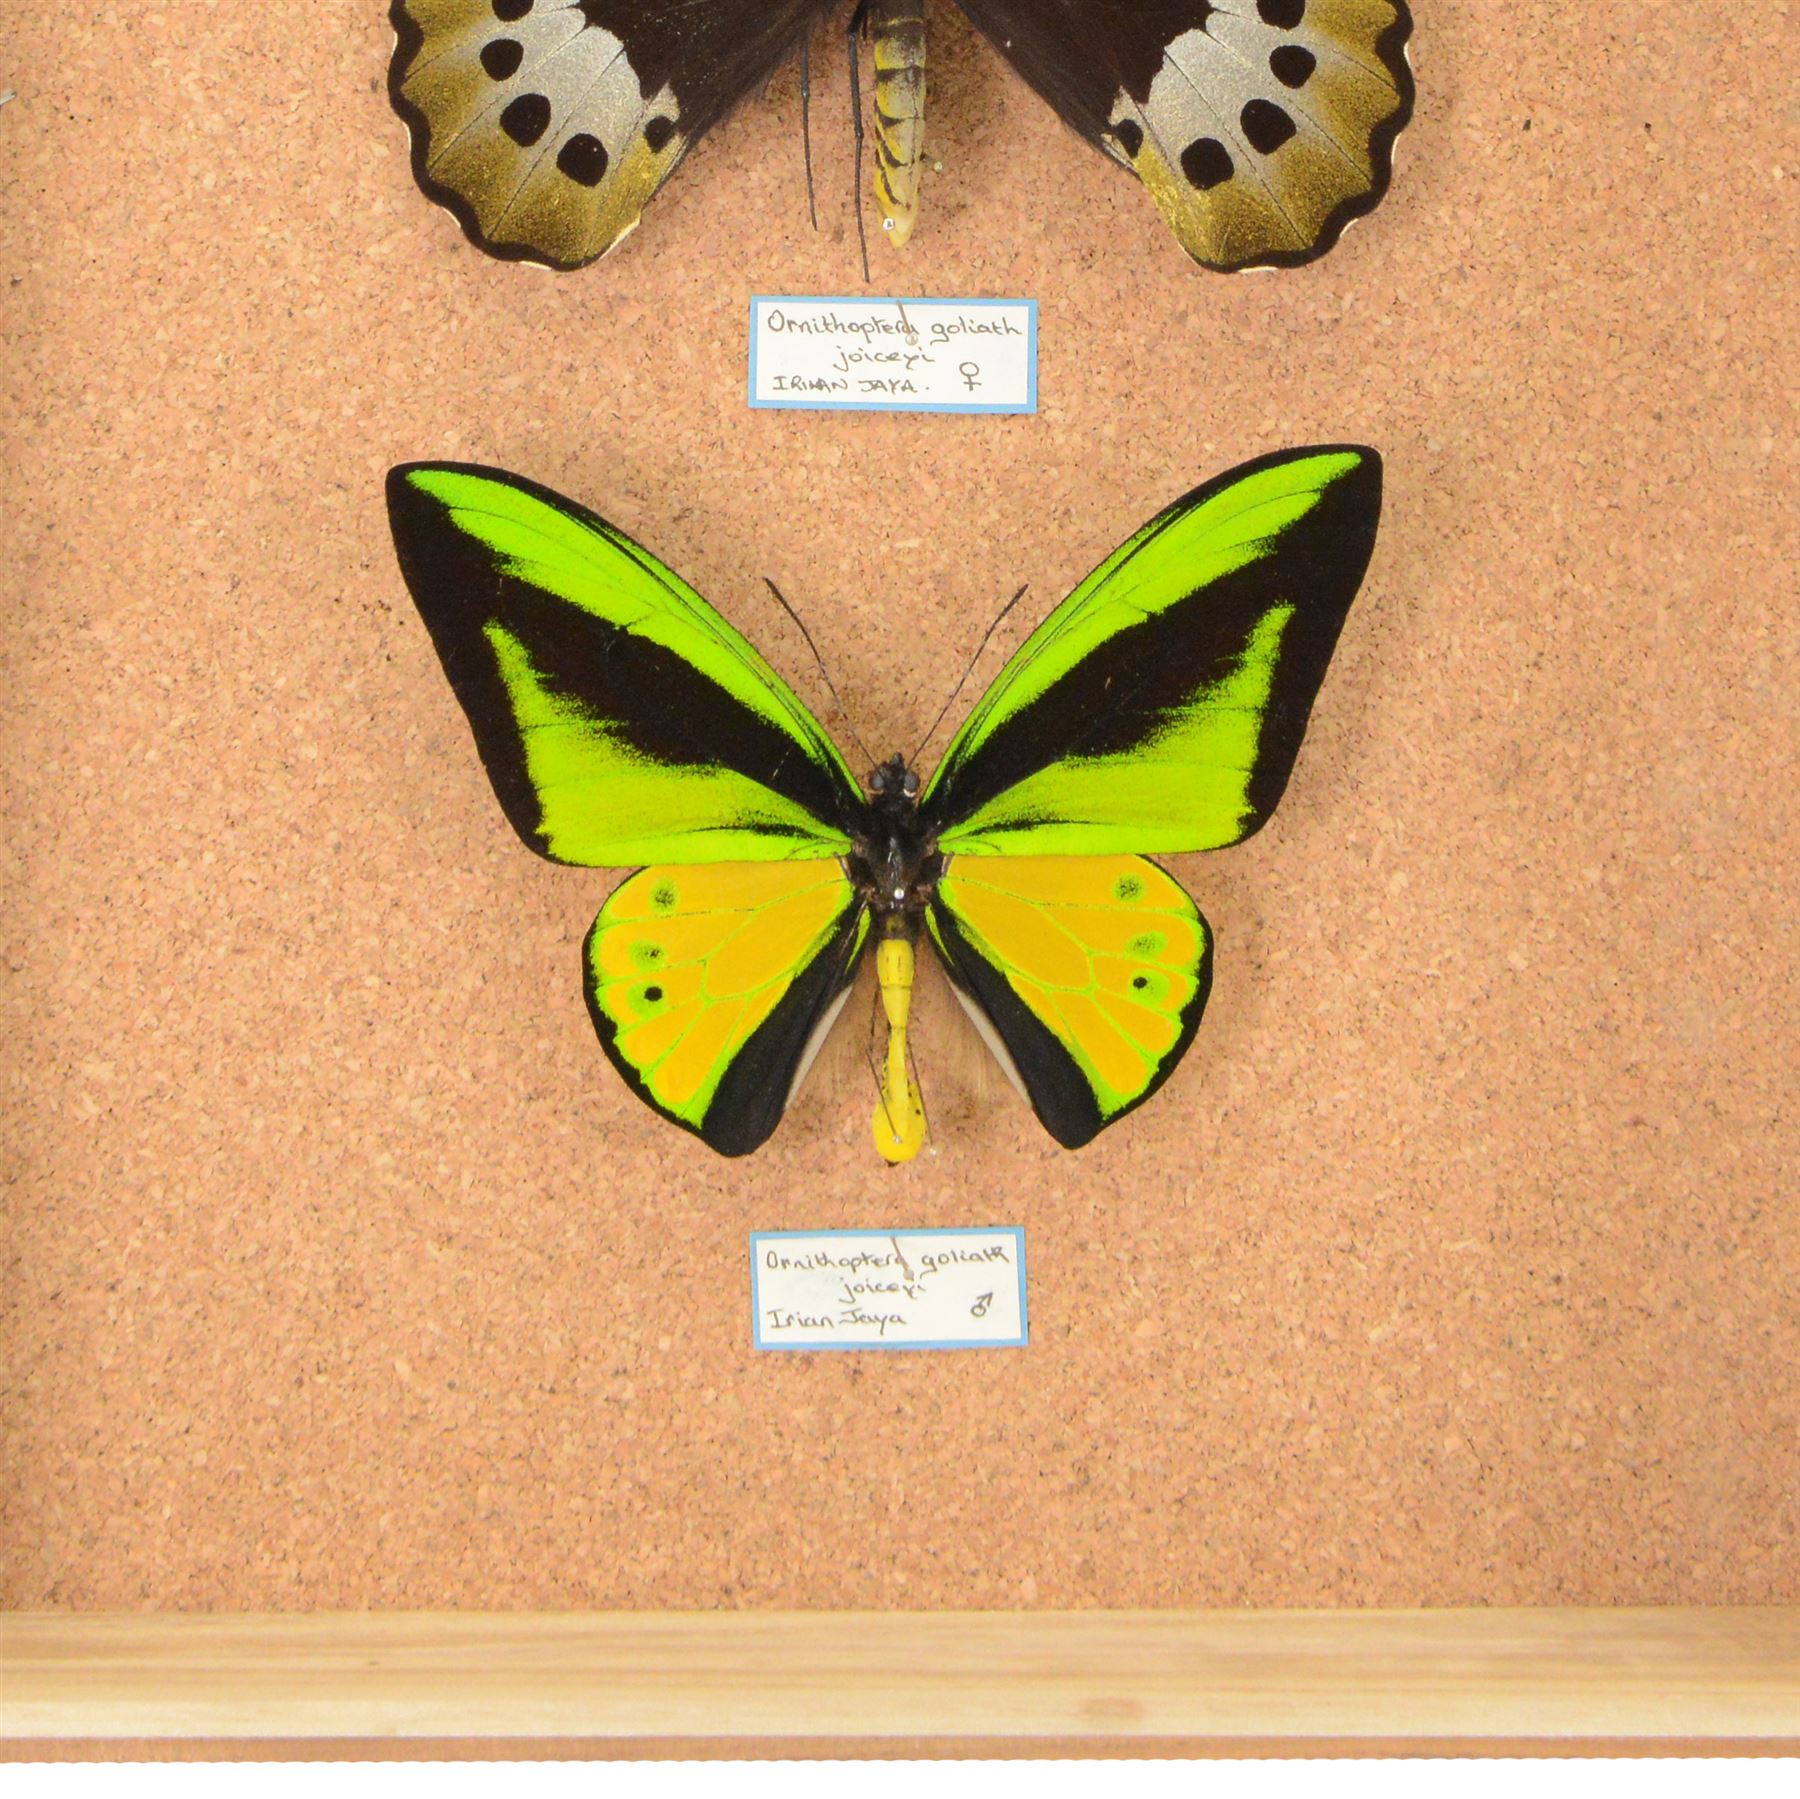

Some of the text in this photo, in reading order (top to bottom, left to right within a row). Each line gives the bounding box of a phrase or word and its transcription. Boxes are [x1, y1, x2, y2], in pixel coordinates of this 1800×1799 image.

[929, 315, 1024, 346] goliath
[833, 345, 935, 372] joiceyi
[920, 1246, 1010, 1279] goliath
[767, 1307, 907, 1335] Irian Jaya
